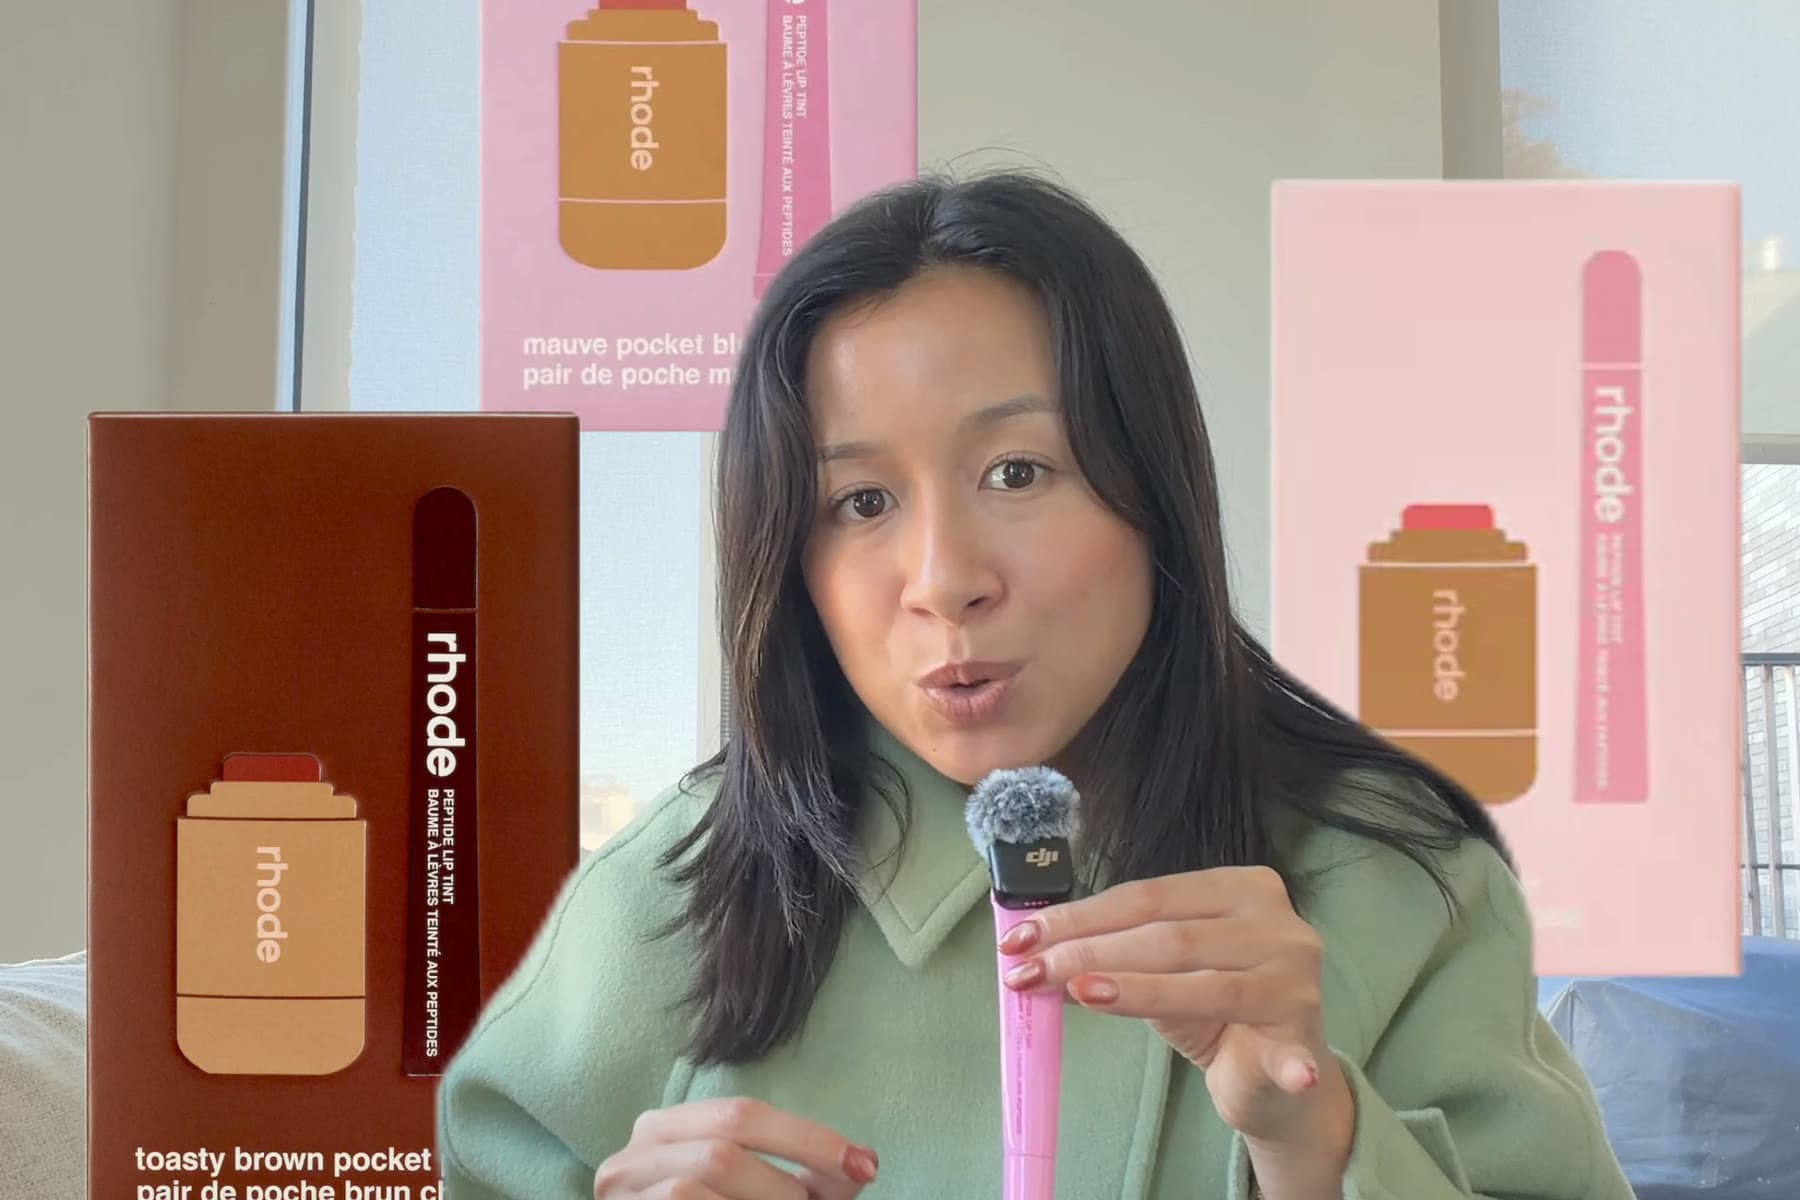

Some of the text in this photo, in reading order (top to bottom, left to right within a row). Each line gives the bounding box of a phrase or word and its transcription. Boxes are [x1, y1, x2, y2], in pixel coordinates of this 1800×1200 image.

[782, 15, 794, 58] BAUME
[795, 15, 808, 66] PEPTIDE
[795, 69, 808, 88] LIP
[630, 65, 660, 170] rhode
[795, 91, 808, 119] TINT
[782, 167, 794, 193] AUX
[782, 196, 794, 256] PEPTIDES
[523, 337, 608, 355] mauve
[616, 333, 704, 360] pocket
[523, 364, 572, 390] pair
[580, 363, 612, 385] de
[621, 363, 701, 390] poche
[1595, 386, 1633, 522] rhode
[1433, 589, 1466, 701] rhode
[426, 632, 467, 777] rhode
[442, 788, 455, 905] PEPTIDE LIP TINT
[256, 846, 289, 963] rhode
[426, 788, 442, 1057] BAUME À LÈVRES TEINTÉ AUX PEPTIDES
[135, 1147, 226, 1177] toasty
[234, 1147, 324, 1171] brown
[334, 1147, 432, 1177] pocket
[137, 1180, 192, 1200] pair
[200, 1180, 236, 1200] de
[246, 1180, 335, 1200] poche
[344, 1180, 411, 1200] brun
